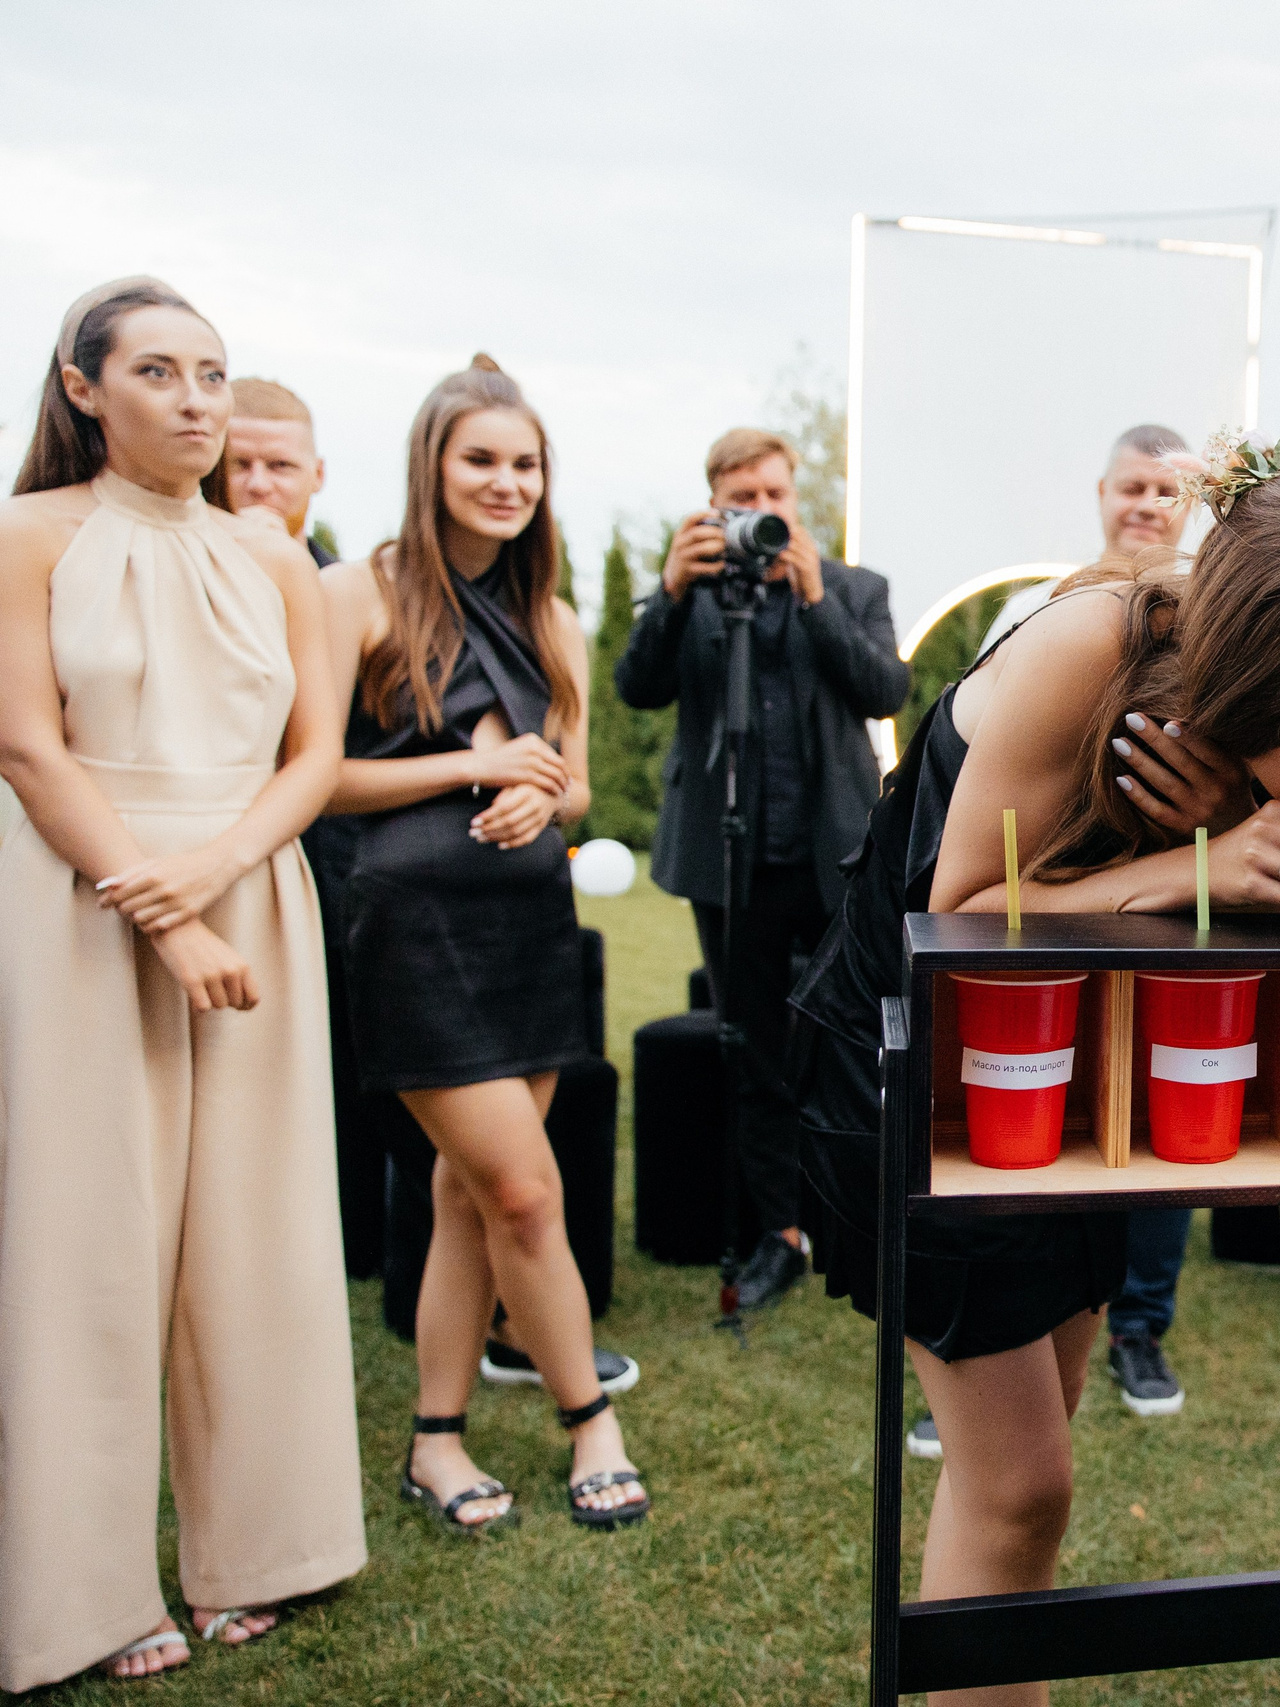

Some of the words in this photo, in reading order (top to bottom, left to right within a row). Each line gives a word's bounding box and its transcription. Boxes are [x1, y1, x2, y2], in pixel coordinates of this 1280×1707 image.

[971, 1059, 1001, 1072] Масло
[1003, 1065, 1038, 1074] из-под
[1039, 1060, 1066, 1072] шпрот
[1201, 1058, 1219, 1068] Сок
